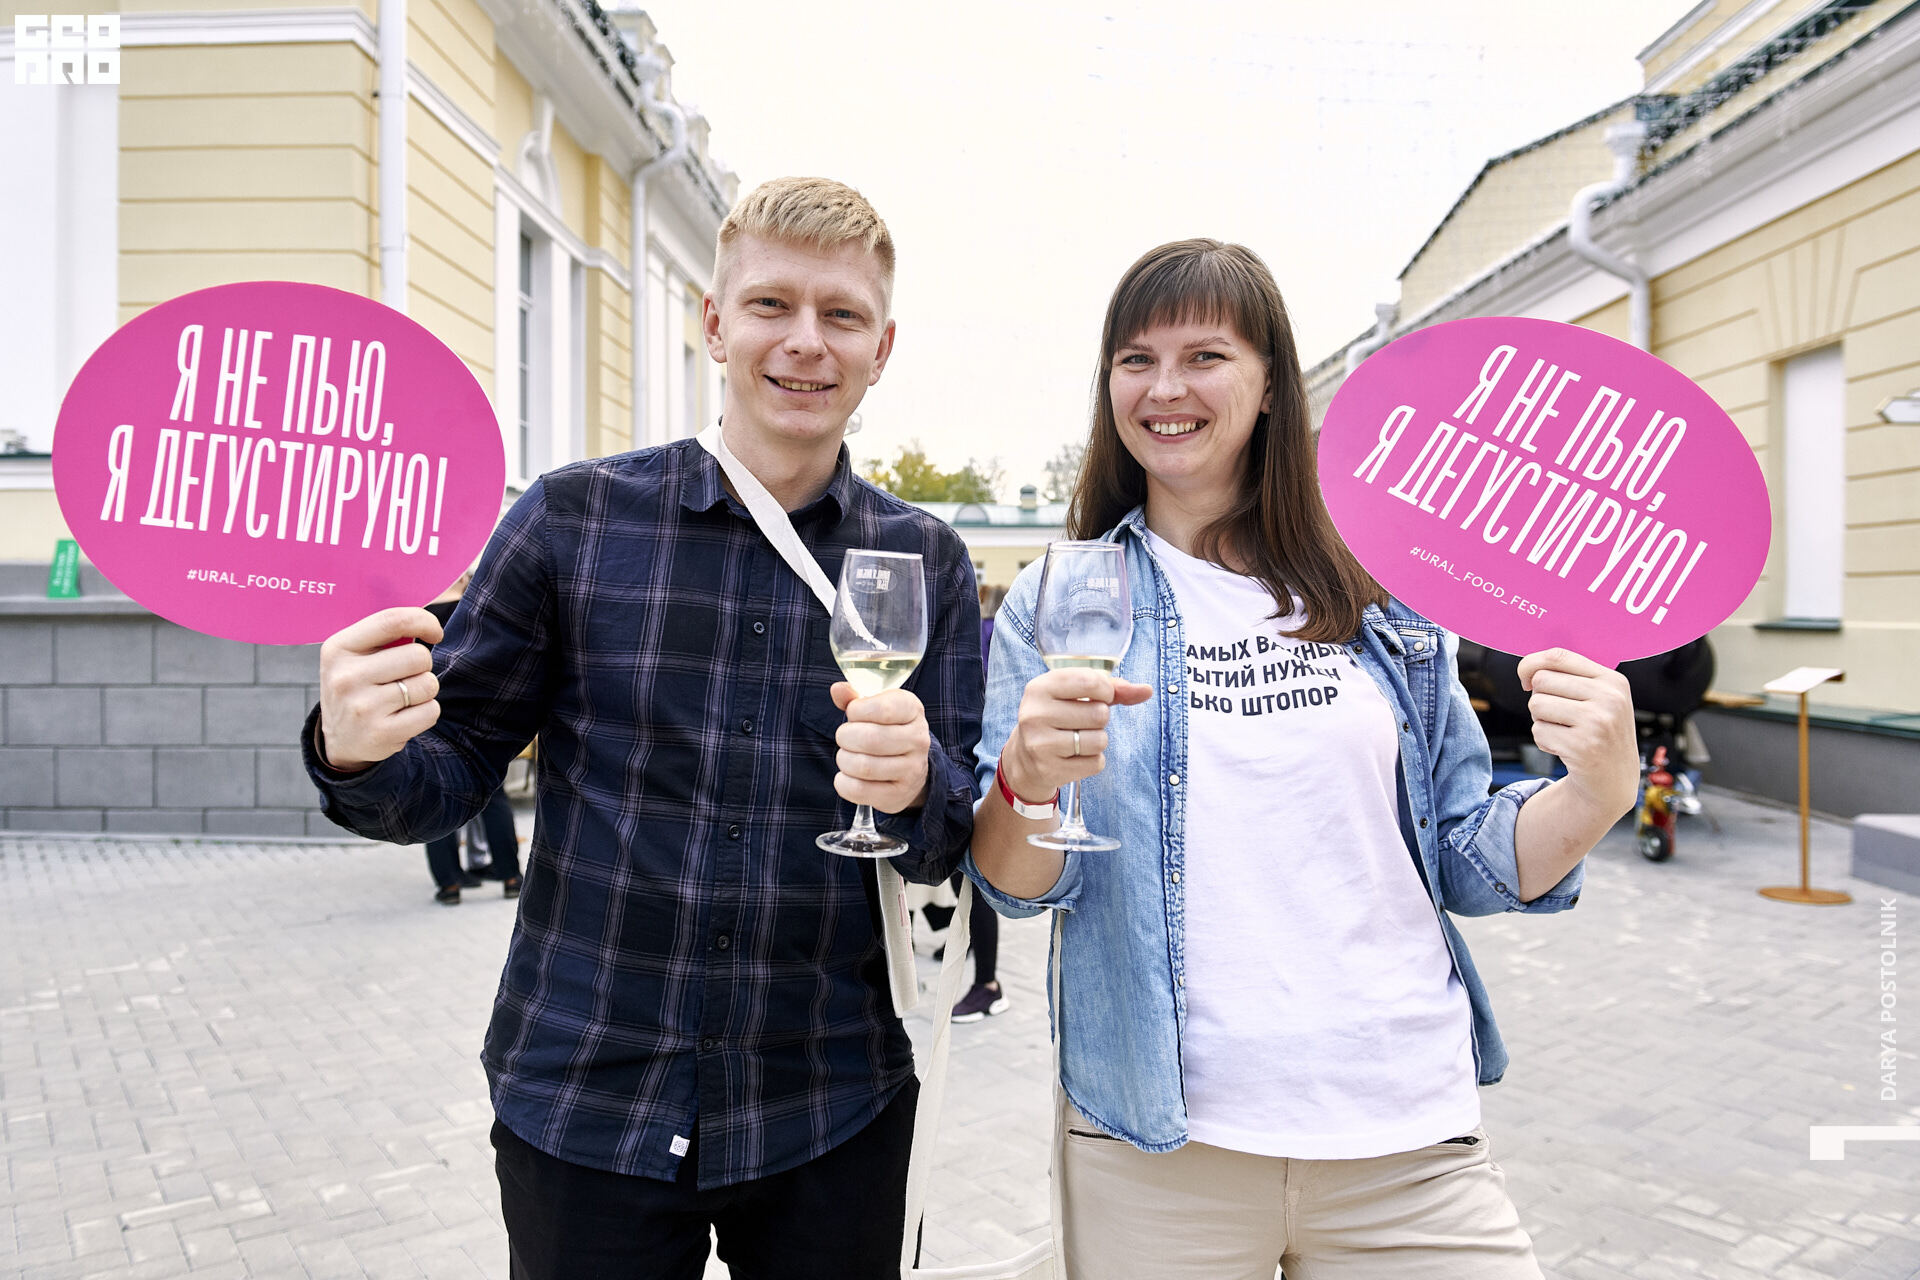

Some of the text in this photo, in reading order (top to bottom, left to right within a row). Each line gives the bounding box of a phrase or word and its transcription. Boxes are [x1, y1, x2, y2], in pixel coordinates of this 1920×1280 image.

[170, 324, 394, 446] Я НЕ ПЬЮ,
[1453, 345, 1687, 512] Я НЕ ПЬЮ,
[100, 424, 448, 556] Я ДЕГУСТИРУЮ!
[1352, 404, 1709, 625] Я ДЕГУСТИРУЮ!
[186, 569, 337, 595] #URAL_FOOD_FEST
[1409, 546, 1548, 619] #URAL_FOOD_FEST
[1186, 638, 1252, 662] АМЫХ
[1190, 685, 1339, 717] ЬКО ШТОПОР
